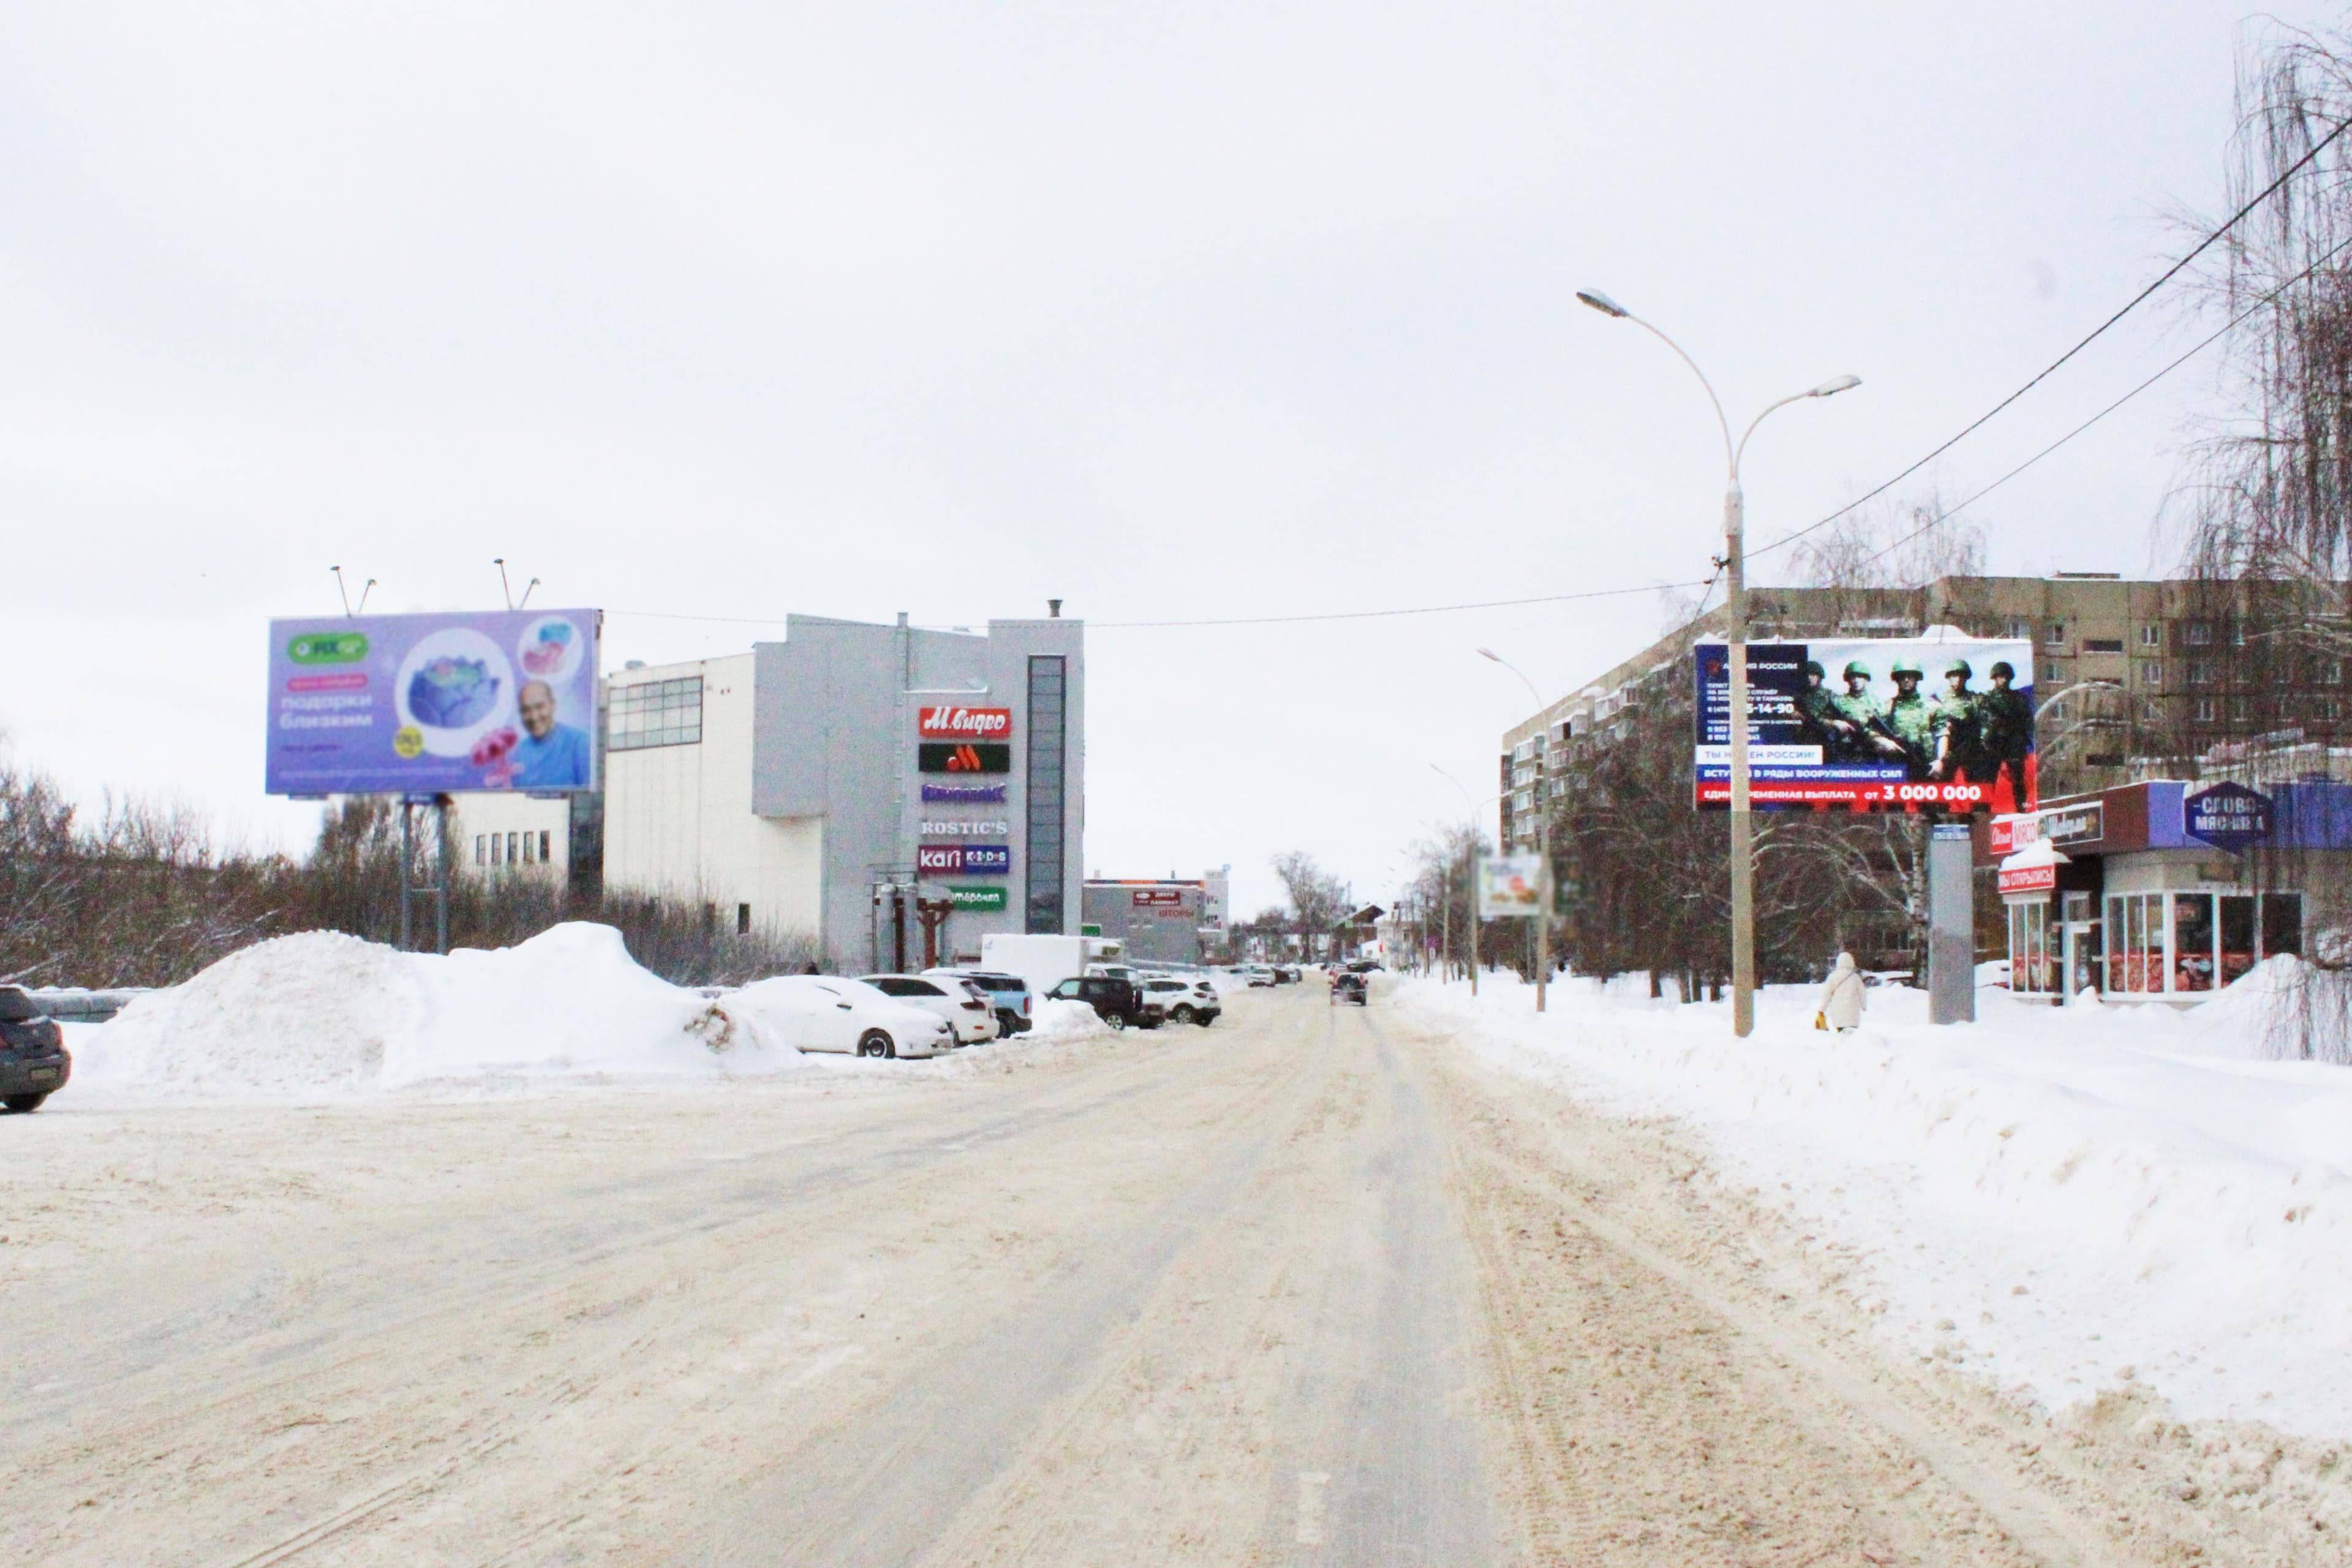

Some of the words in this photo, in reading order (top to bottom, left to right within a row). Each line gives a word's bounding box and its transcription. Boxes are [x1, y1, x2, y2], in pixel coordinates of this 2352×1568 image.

[1763, 770, 1793, 778] РЯДЫ
[1796, 769, 1878, 778] ВООРУЖЕННЫХ
[1804, 791, 1856, 799] ВЫПЛАТА
[1883, 786, 1896, 800] 3
[1899, 786, 1938, 800] 000
[1942, 786, 1981, 800] 000
[921, 821, 1008, 834] ROSTIC'S
